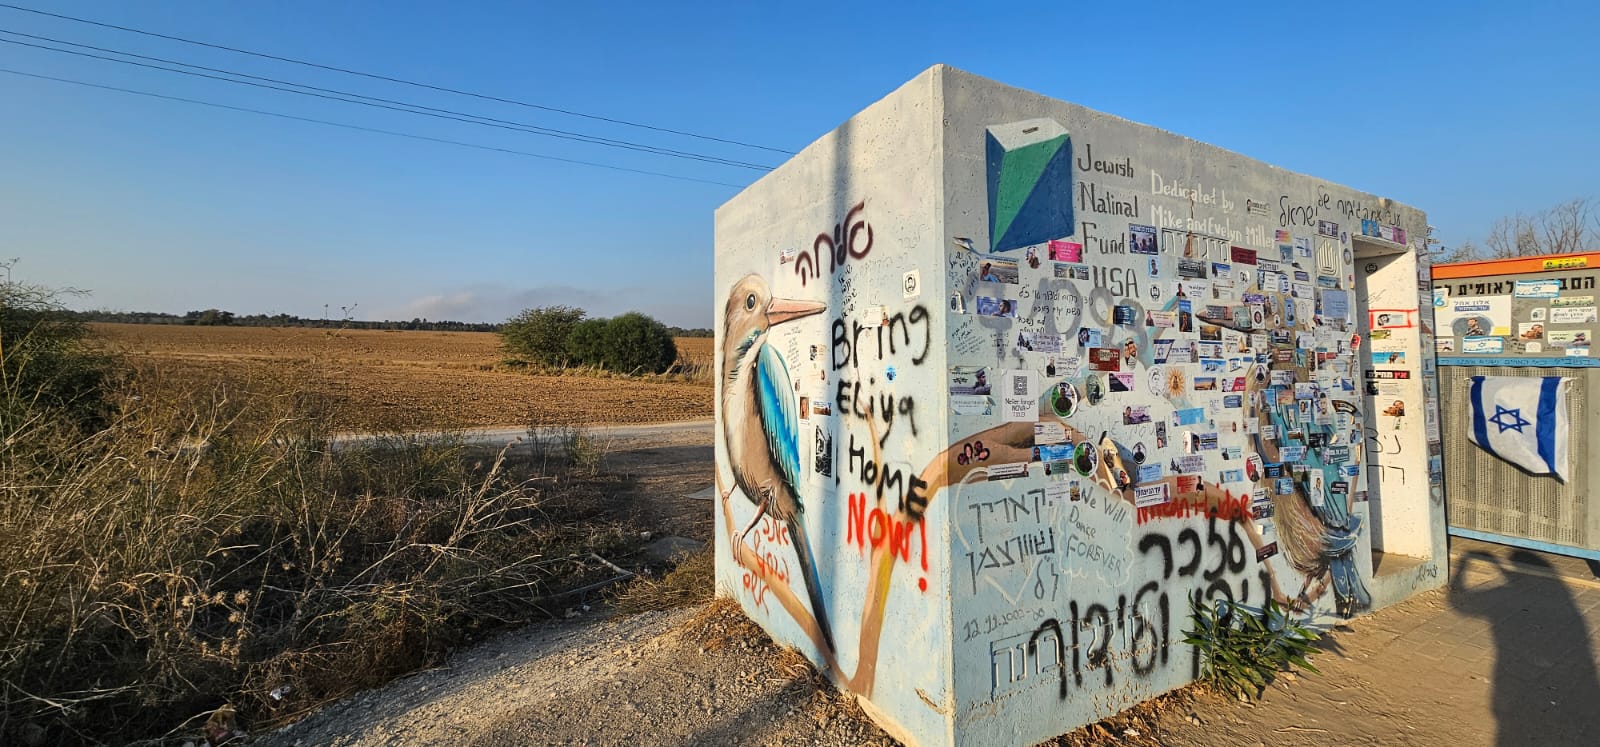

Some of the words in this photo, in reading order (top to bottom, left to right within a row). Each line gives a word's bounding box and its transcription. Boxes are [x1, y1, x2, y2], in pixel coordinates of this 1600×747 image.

[1078, 143, 1134, 178] Jewish
[1151, 170, 1216, 205] Dedicated
[1222, 190, 1235, 214] by
[1279, 195, 1319, 227] ישראל
[1317, 184, 1331, 210] של
[1081, 221, 1125, 256] Fund
[1151, 204, 1183, 229] Mike
[1208, 216, 1242, 243] Evelyn
[795, 200, 873, 287] סליחה
[1093, 265, 1140, 298] USA
[831, 304, 931, 372] Bring
[965, 527, 1055, 595] שוורצמן
[1139, 506, 1246, 581] לזכר
